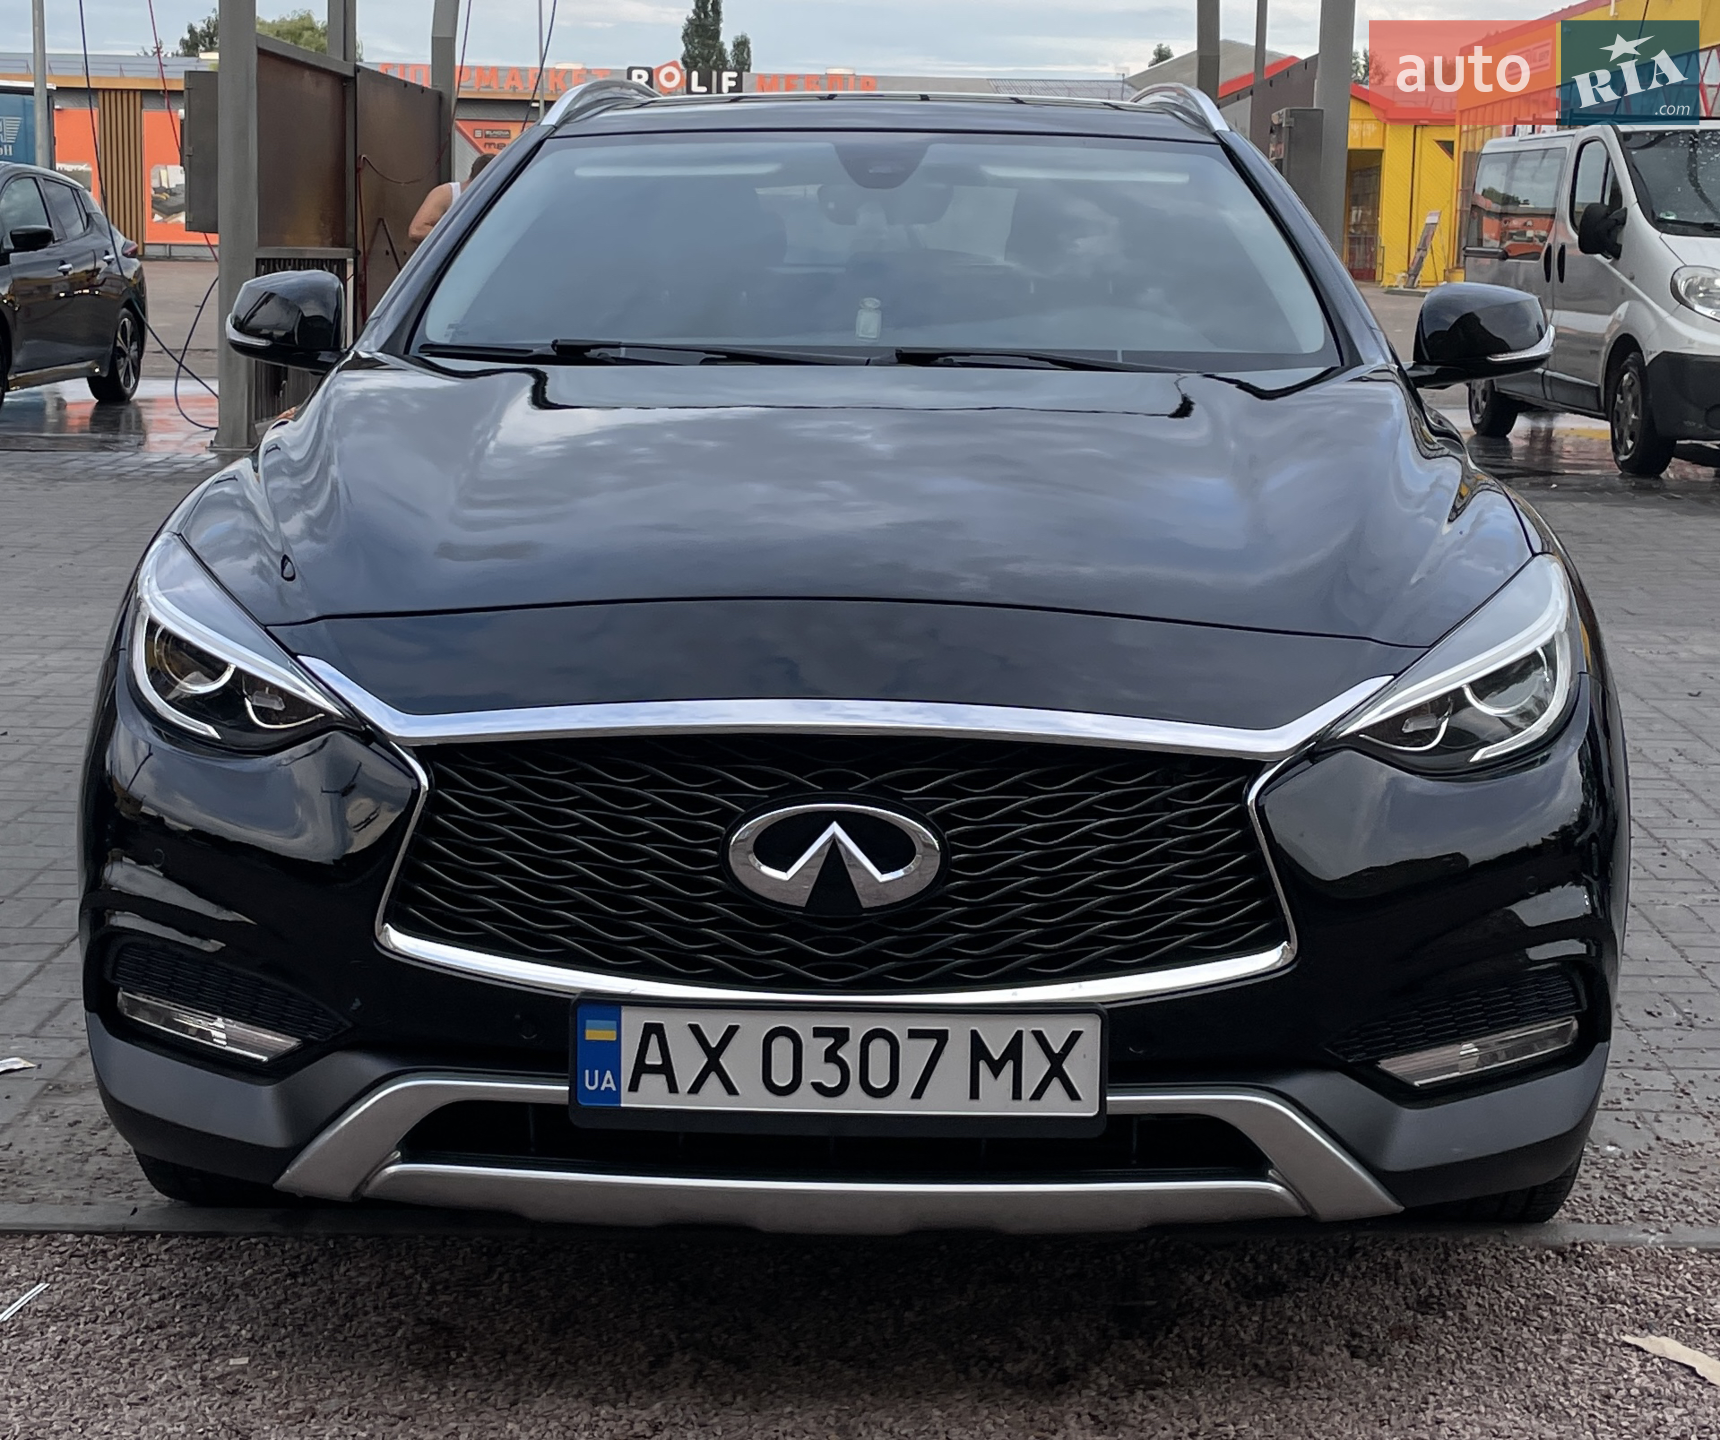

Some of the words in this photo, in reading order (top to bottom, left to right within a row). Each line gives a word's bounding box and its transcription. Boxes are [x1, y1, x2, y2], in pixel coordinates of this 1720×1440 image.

[631, 65, 738, 94] ROLF
[627, 1021, 740, 1097] AX
[761, 1025, 949, 1100] 0307
[969, 1028, 1084, 1102] MX
[584, 1069, 617, 1092] UA
